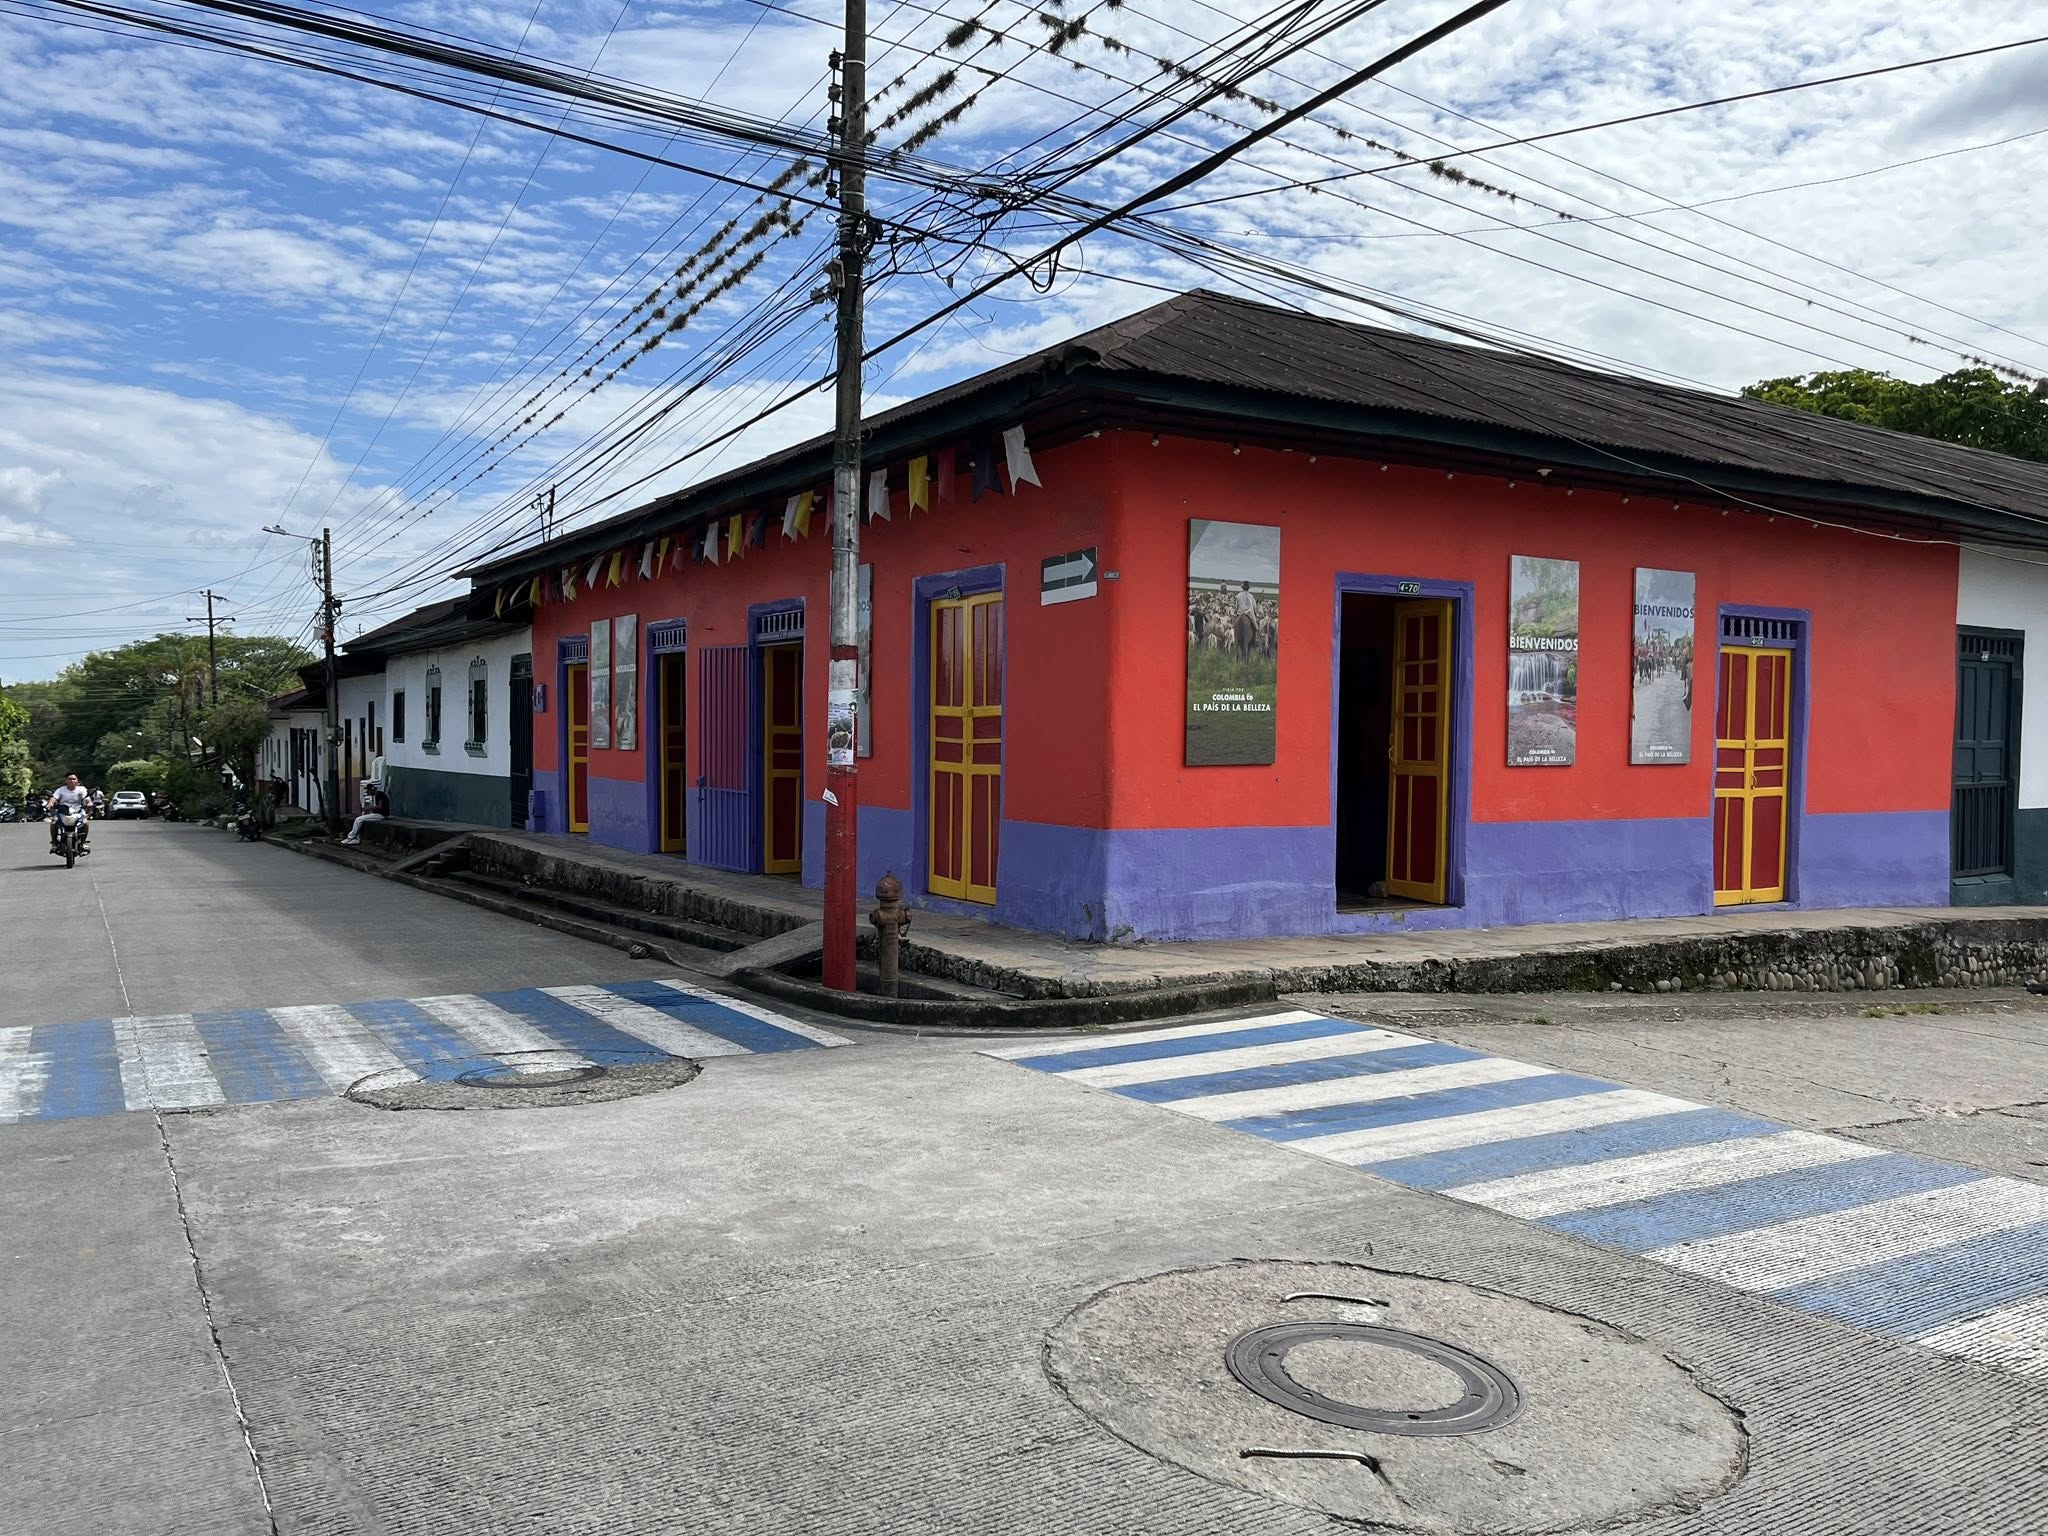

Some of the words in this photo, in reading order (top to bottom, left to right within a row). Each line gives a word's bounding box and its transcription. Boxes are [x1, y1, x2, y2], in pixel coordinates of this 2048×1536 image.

[1400, 583, 1418, 593] 4-70
[1634, 604, 1695, 619] BIENVENIDOS
[1509, 636, 1579, 651] BIENVENIDOS
[1212, 693, 1246, 701] COLOMBIA
[1193, 703, 1201, 711] EL
[1203, 702, 1220, 711] PAÍS
[1221, 703, 1230, 711] DE
[1232, 703, 1241, 711] LA
[1243, 703, 1271, 711] BELLEZA
